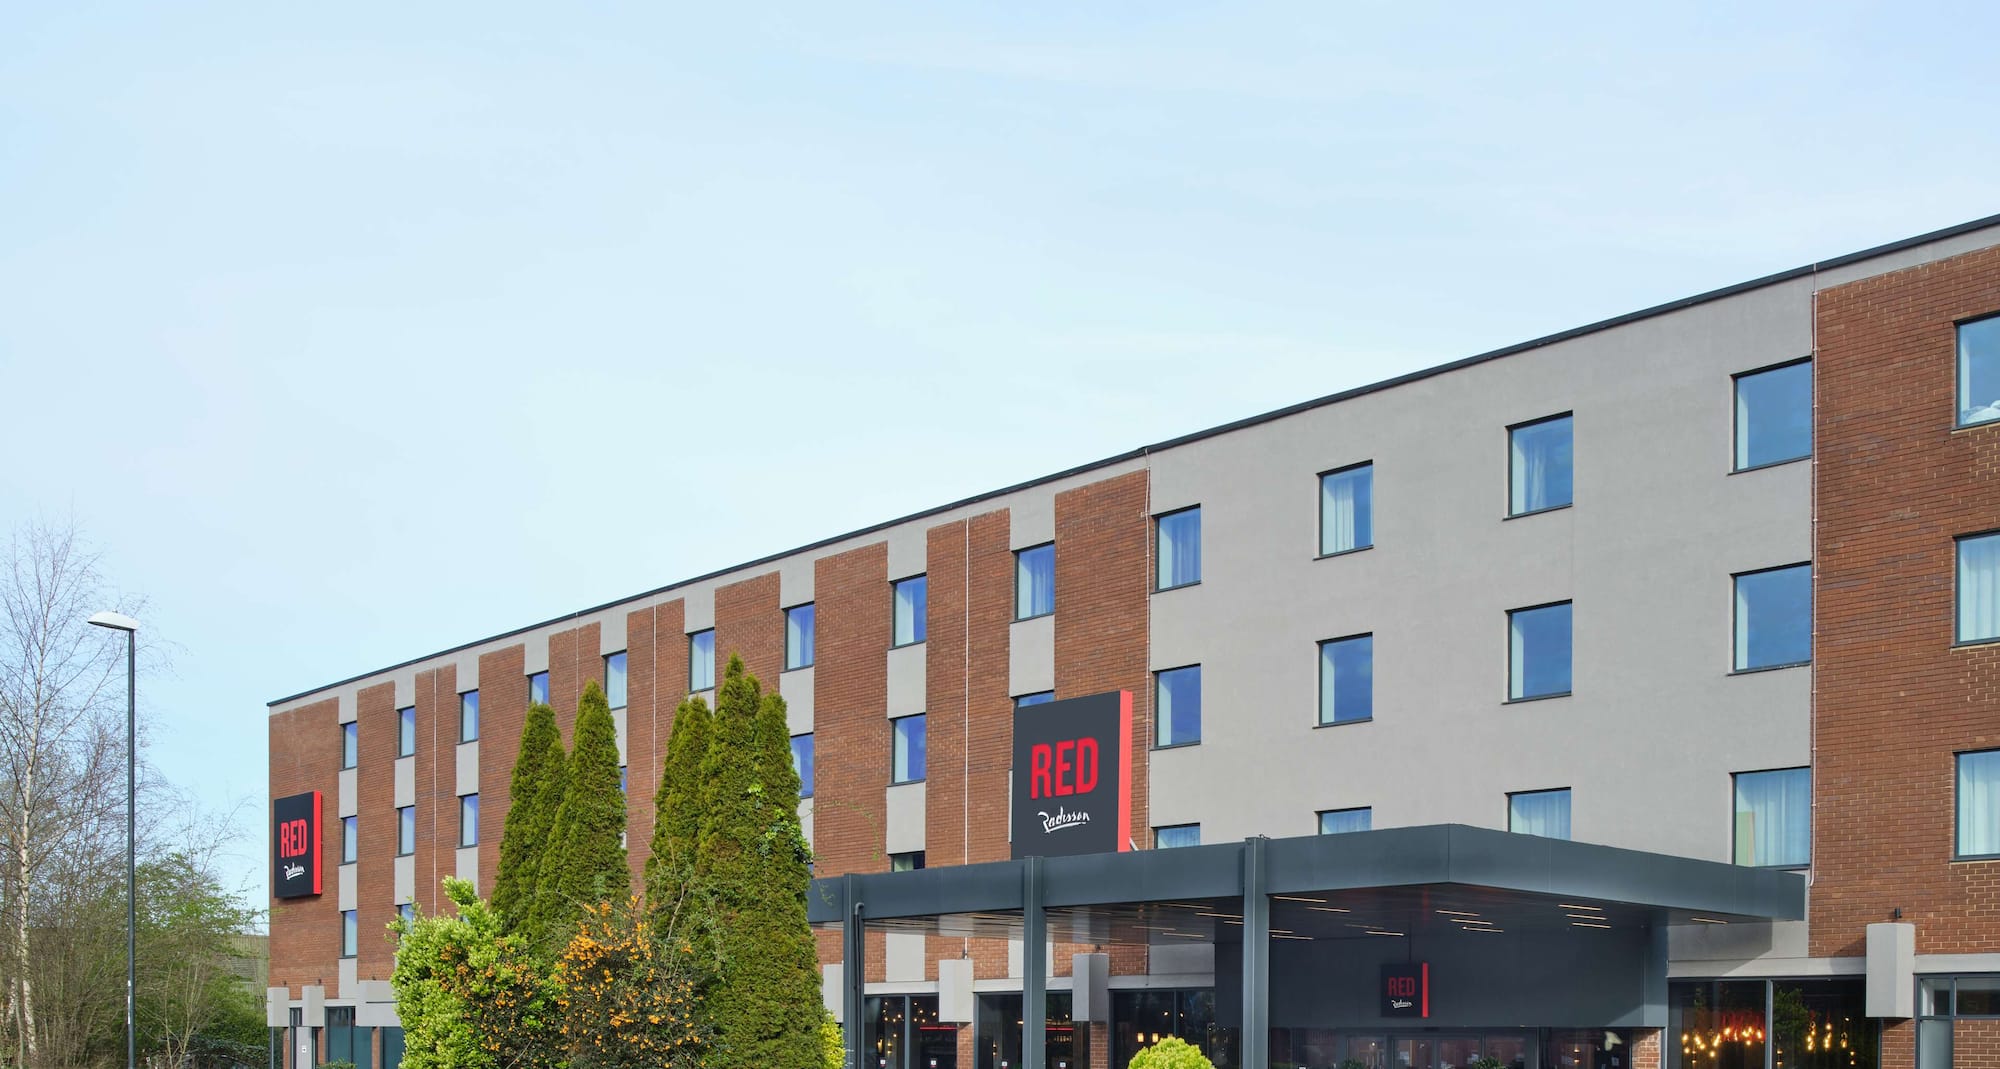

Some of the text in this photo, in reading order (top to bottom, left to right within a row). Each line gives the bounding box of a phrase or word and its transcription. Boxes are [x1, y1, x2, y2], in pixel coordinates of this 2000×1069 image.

[1030, 737, 1099, 800] RED
[1037, 806, 1091, 833] Radisson
[281, 819, 308, 858] RED
[1388, 976, 1416, 997] RED
